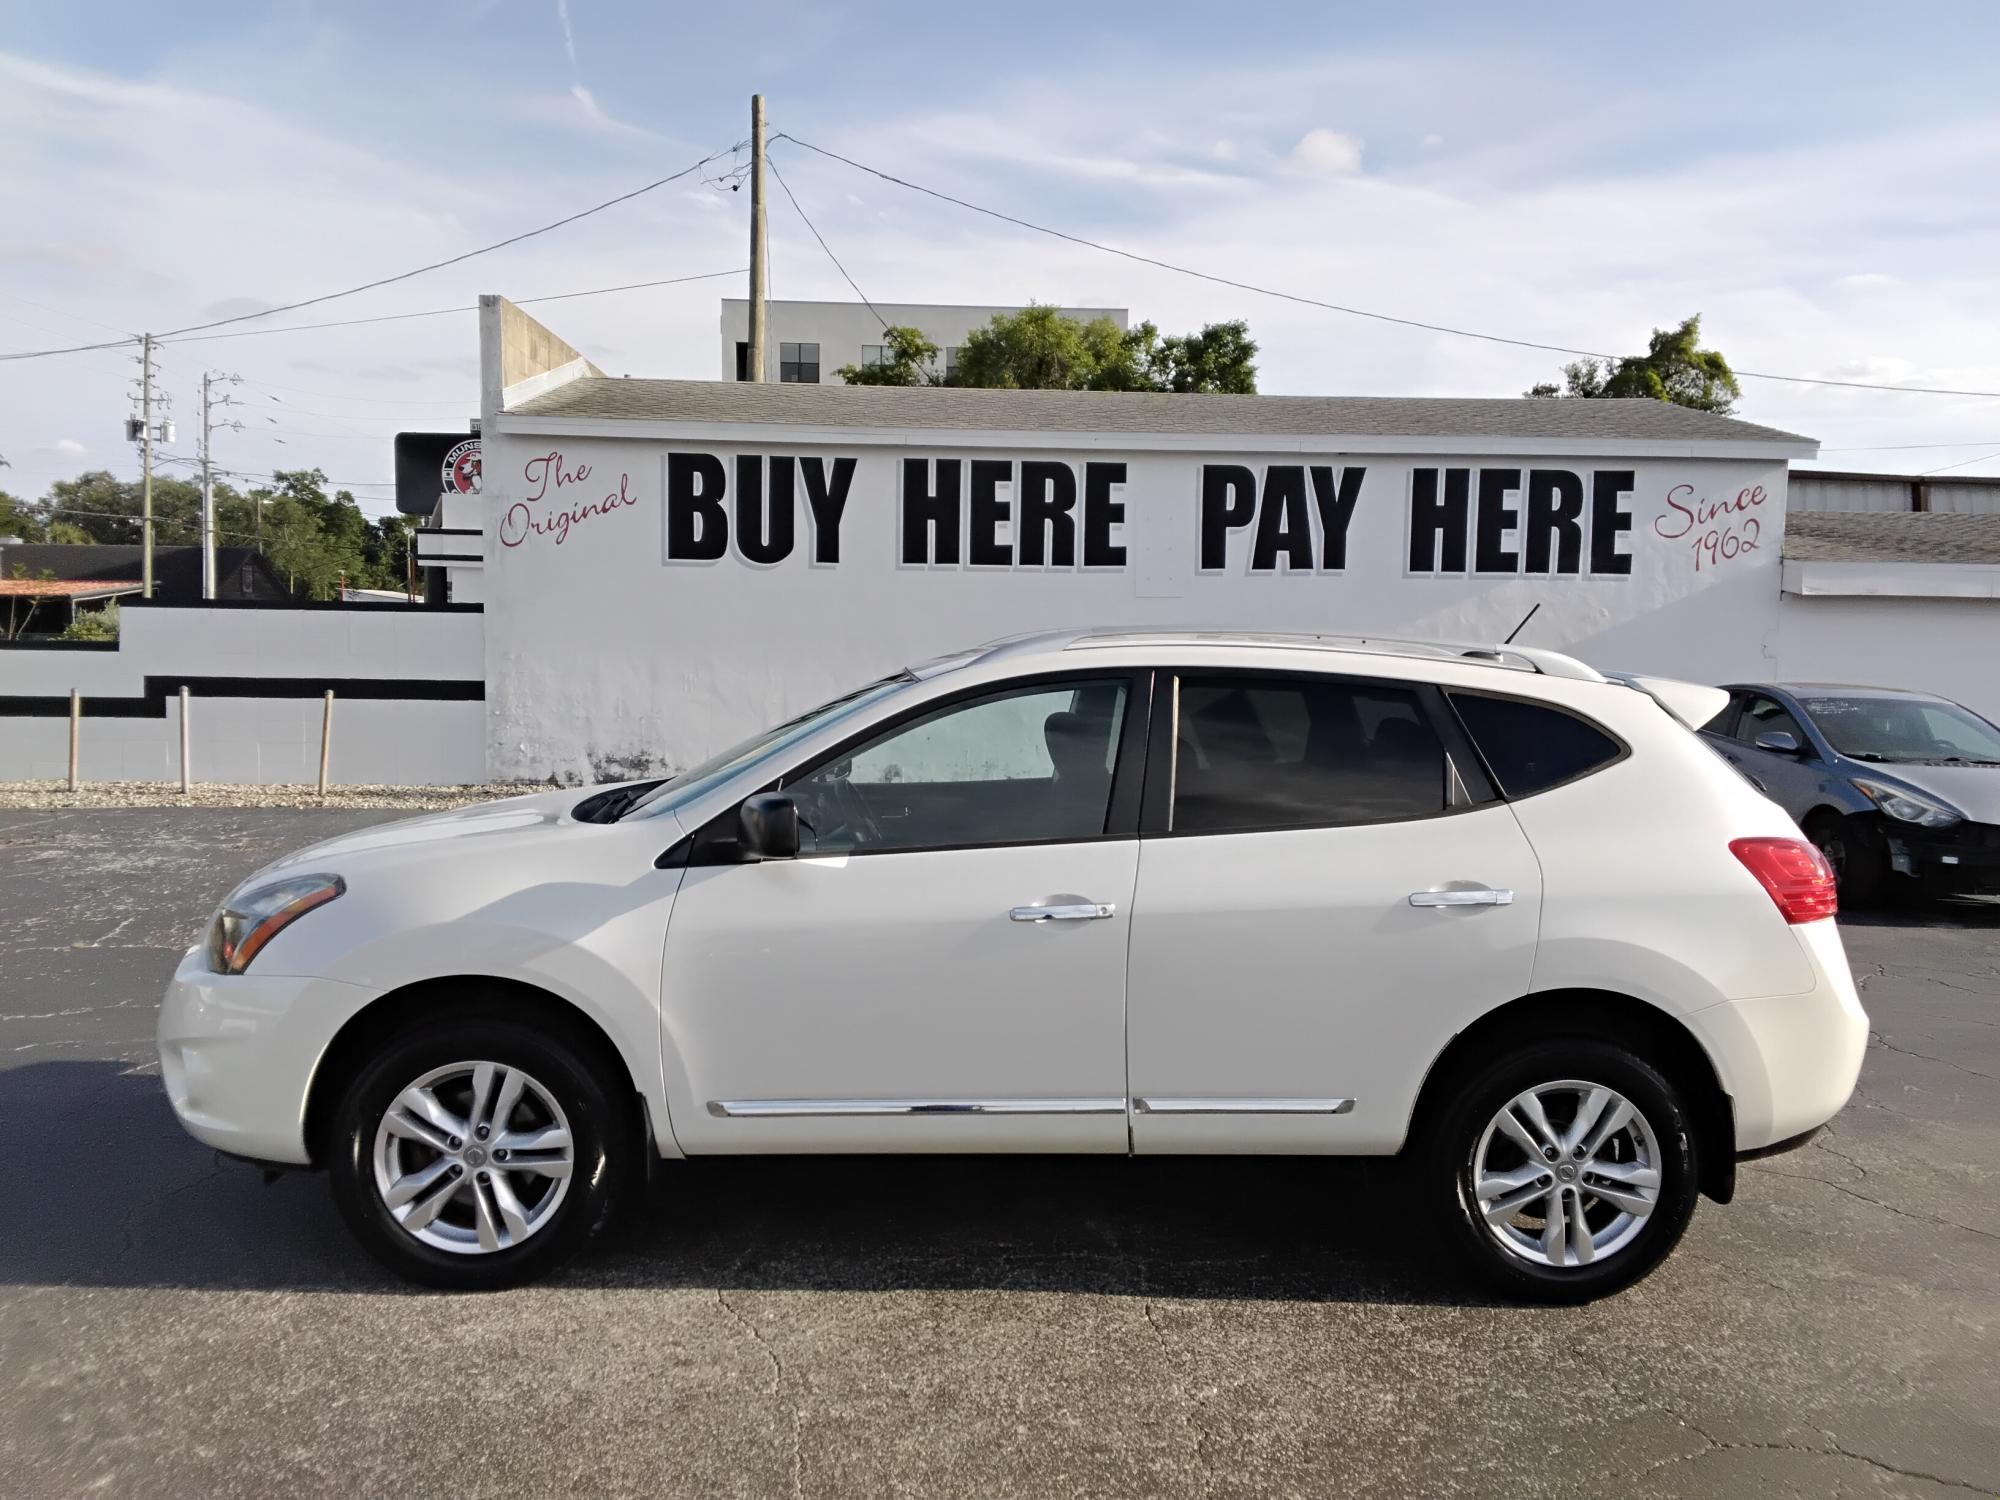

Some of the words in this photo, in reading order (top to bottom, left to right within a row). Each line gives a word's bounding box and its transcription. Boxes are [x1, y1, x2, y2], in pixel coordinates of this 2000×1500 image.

[524, 451, 592, 501] The
[500, 473, 637, 547] Original
[667, 452, 858, 564] BUY
[902, 458, 1127, 566] HERE
[1201, 464, 1367, 570] PAY
[1409, 468, 1635, 574] HERE
[1654, 484, 1767, 539] Since
[1691, 518, 1760, 571] 1962
